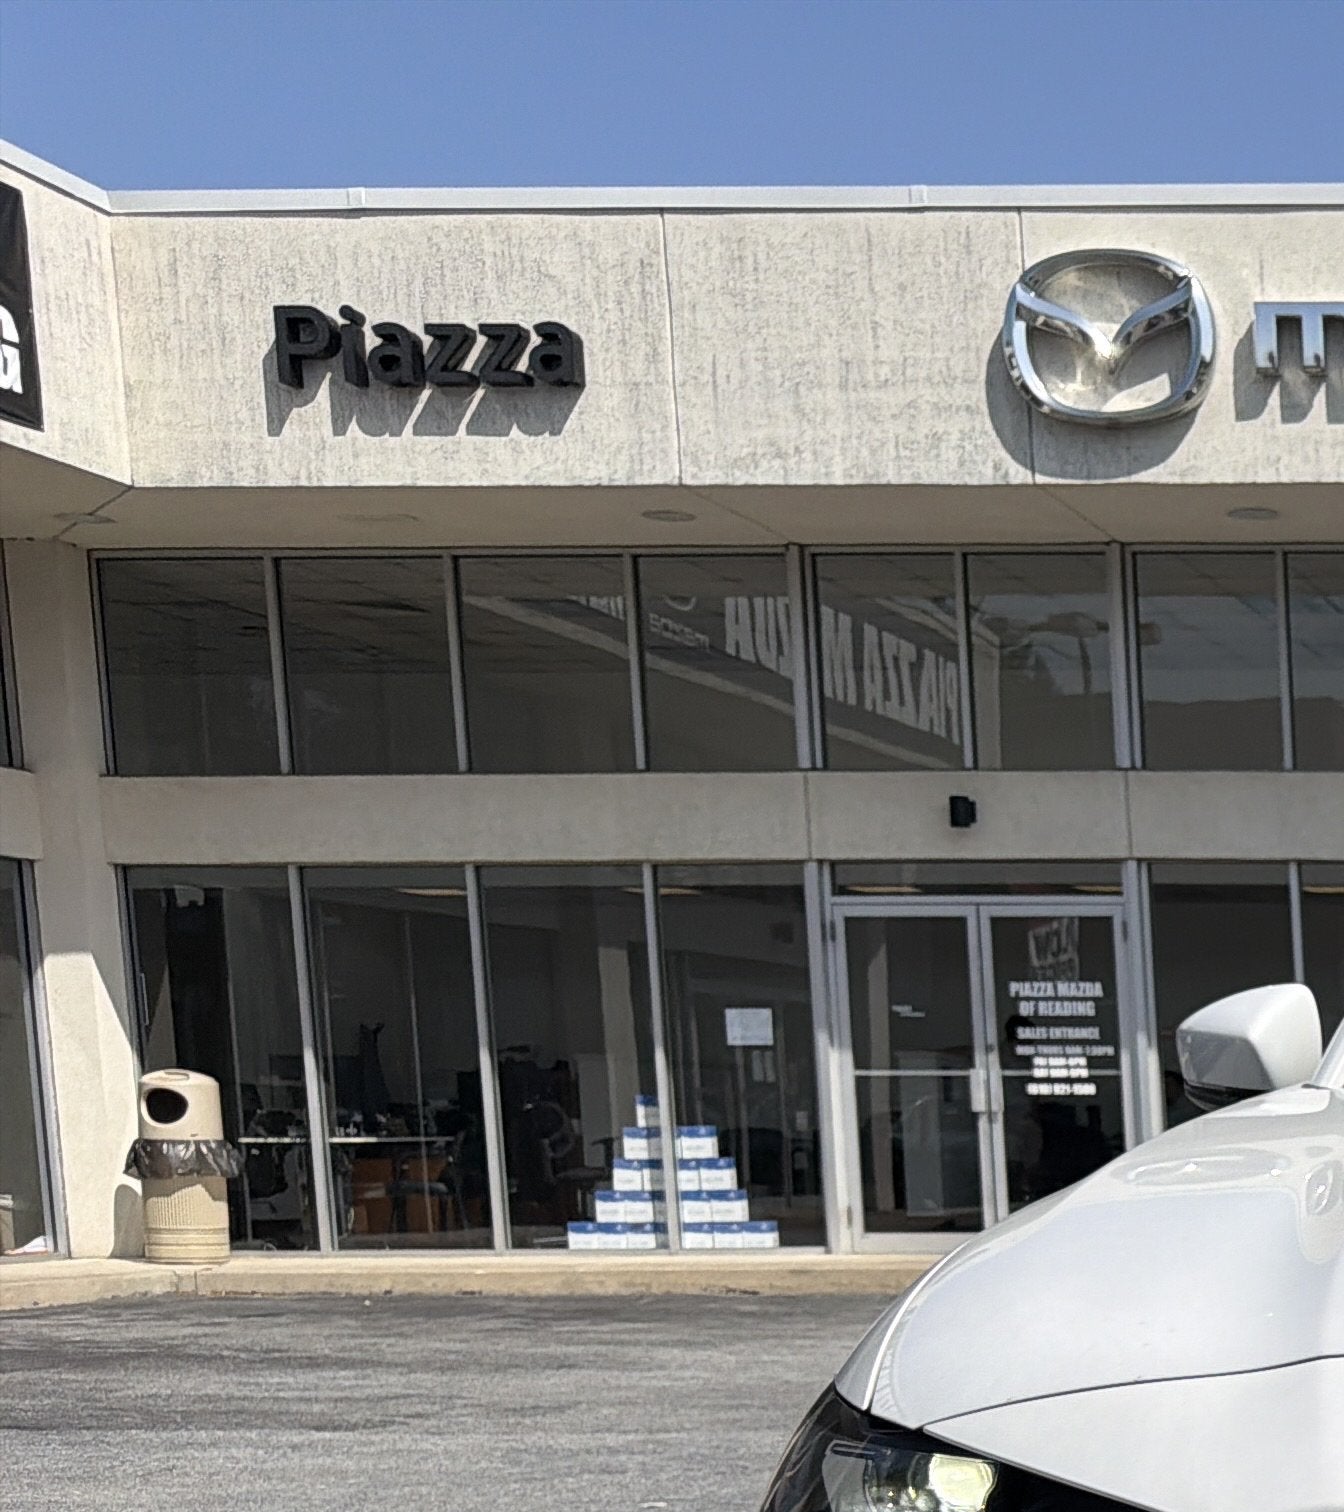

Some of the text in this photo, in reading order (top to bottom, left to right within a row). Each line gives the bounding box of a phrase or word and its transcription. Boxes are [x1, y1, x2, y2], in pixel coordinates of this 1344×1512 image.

[273, 304, 586, 389] Piazza
[1009, 981, 1104, 997] PIAZZA MAZDA
[1019, 1001, 1096, 1016] OF READING
[1016, 1026, 1100, 1039] SALES ENTRANCE
